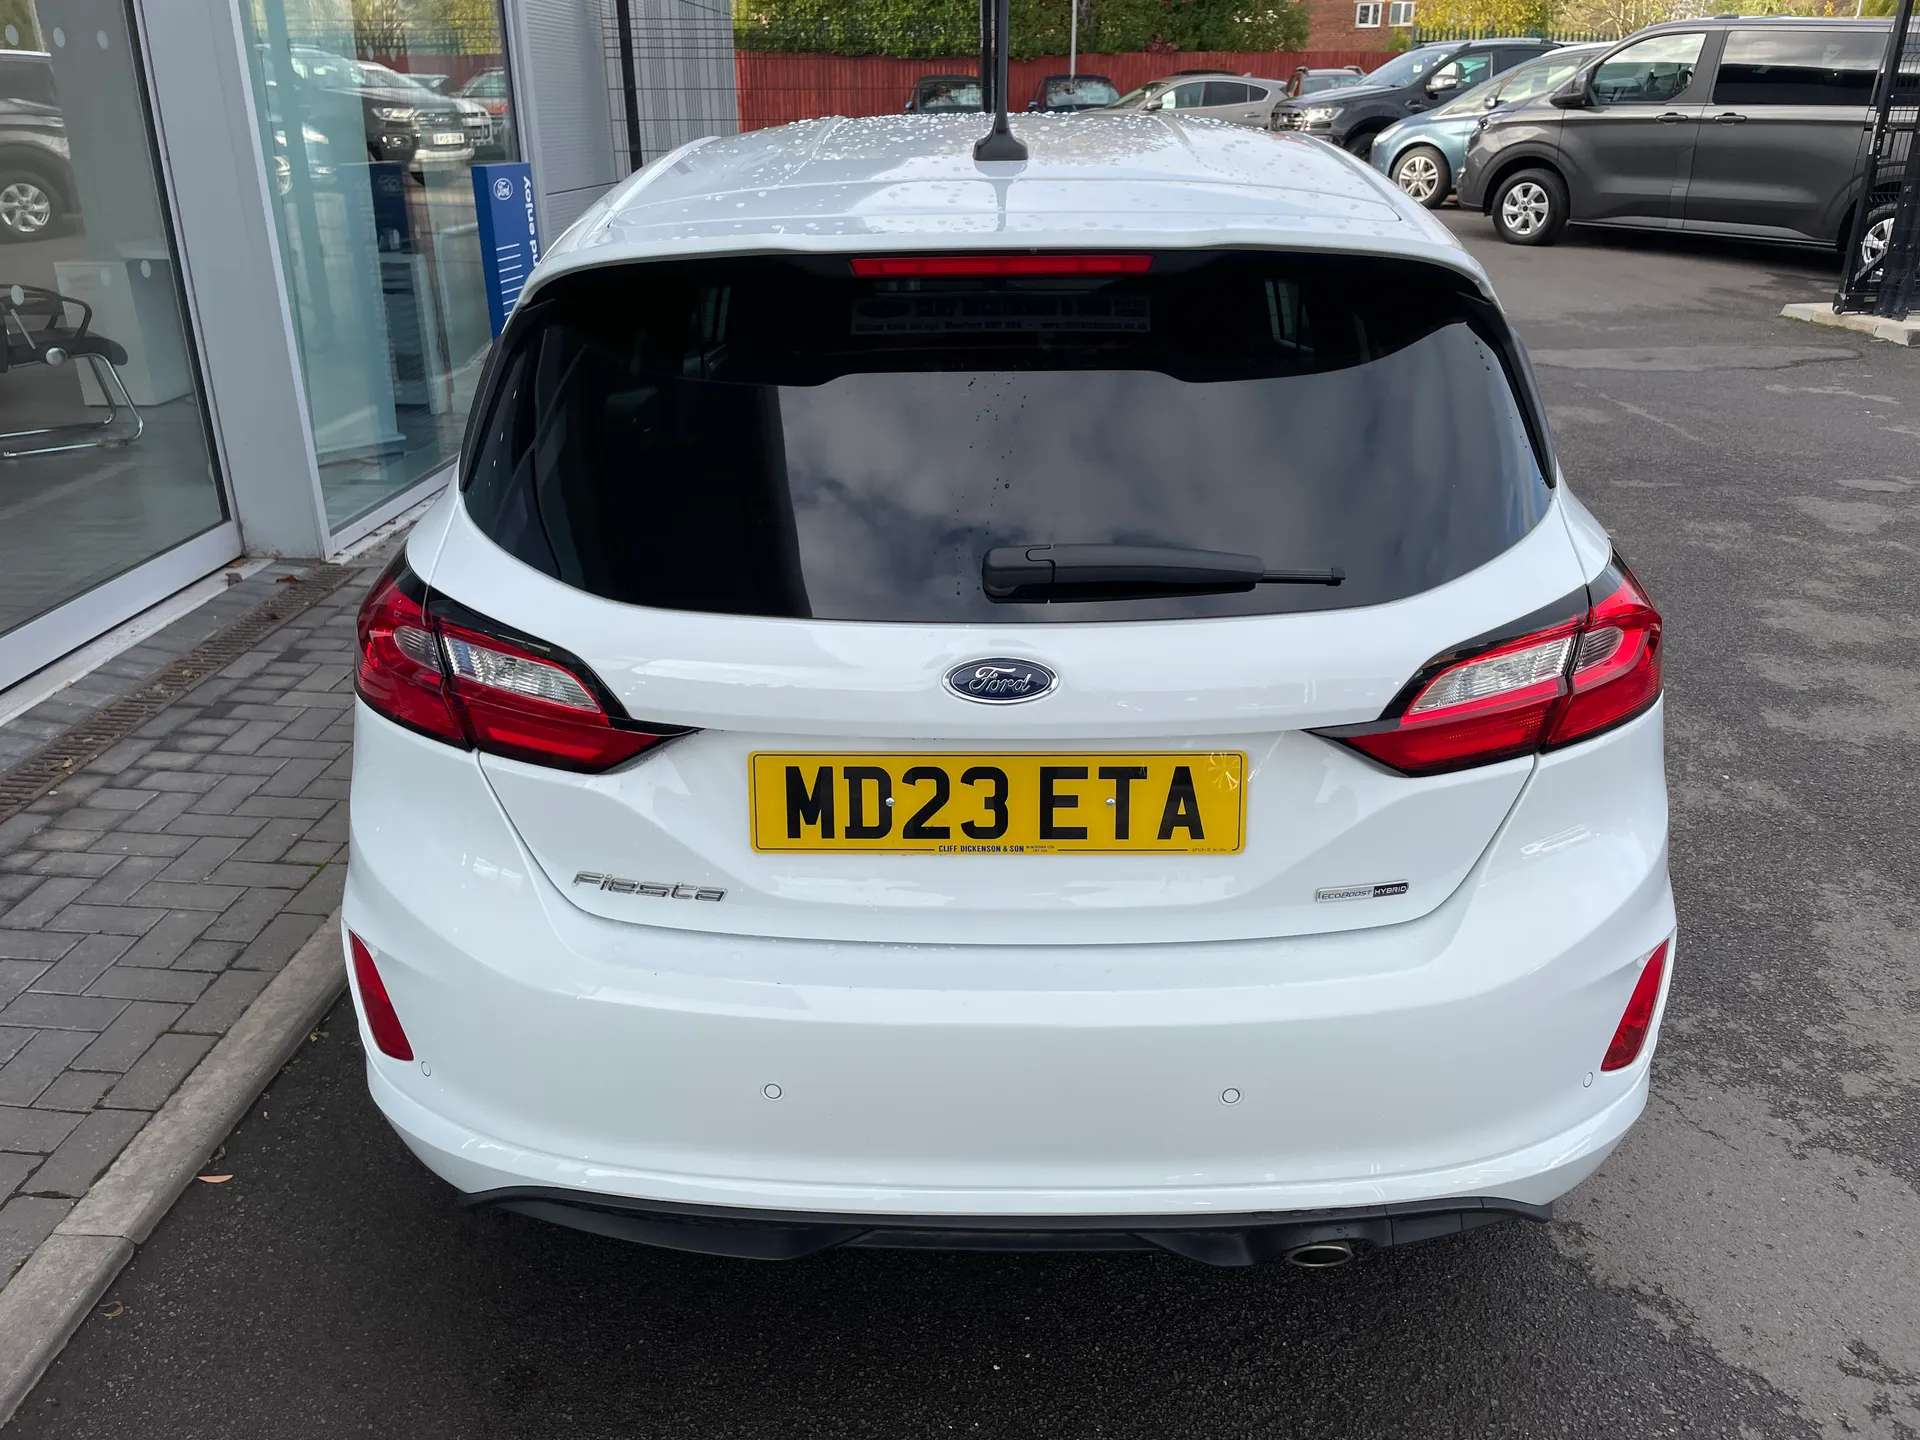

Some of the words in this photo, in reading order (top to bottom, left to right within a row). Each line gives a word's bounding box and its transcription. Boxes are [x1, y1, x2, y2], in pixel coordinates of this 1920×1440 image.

[523, 176, 535, 235] enjoy
[529, 239, 539, 267] nd
[968, 665, 1033, 693] Ford
[784, 765, 1009, 841] MD23
[1039, 766, 1206, 841] ETA
[938, 844, 958, 853] CLIFF
[960, 845, 1001, 853] DICKENSON
[1002, 845, 1008, 853] &
[1009, 845, 1025, 853] SON
[572, 870, 729, 903] Fiesta
[1374, 886, 1407, 895] HYBRID
